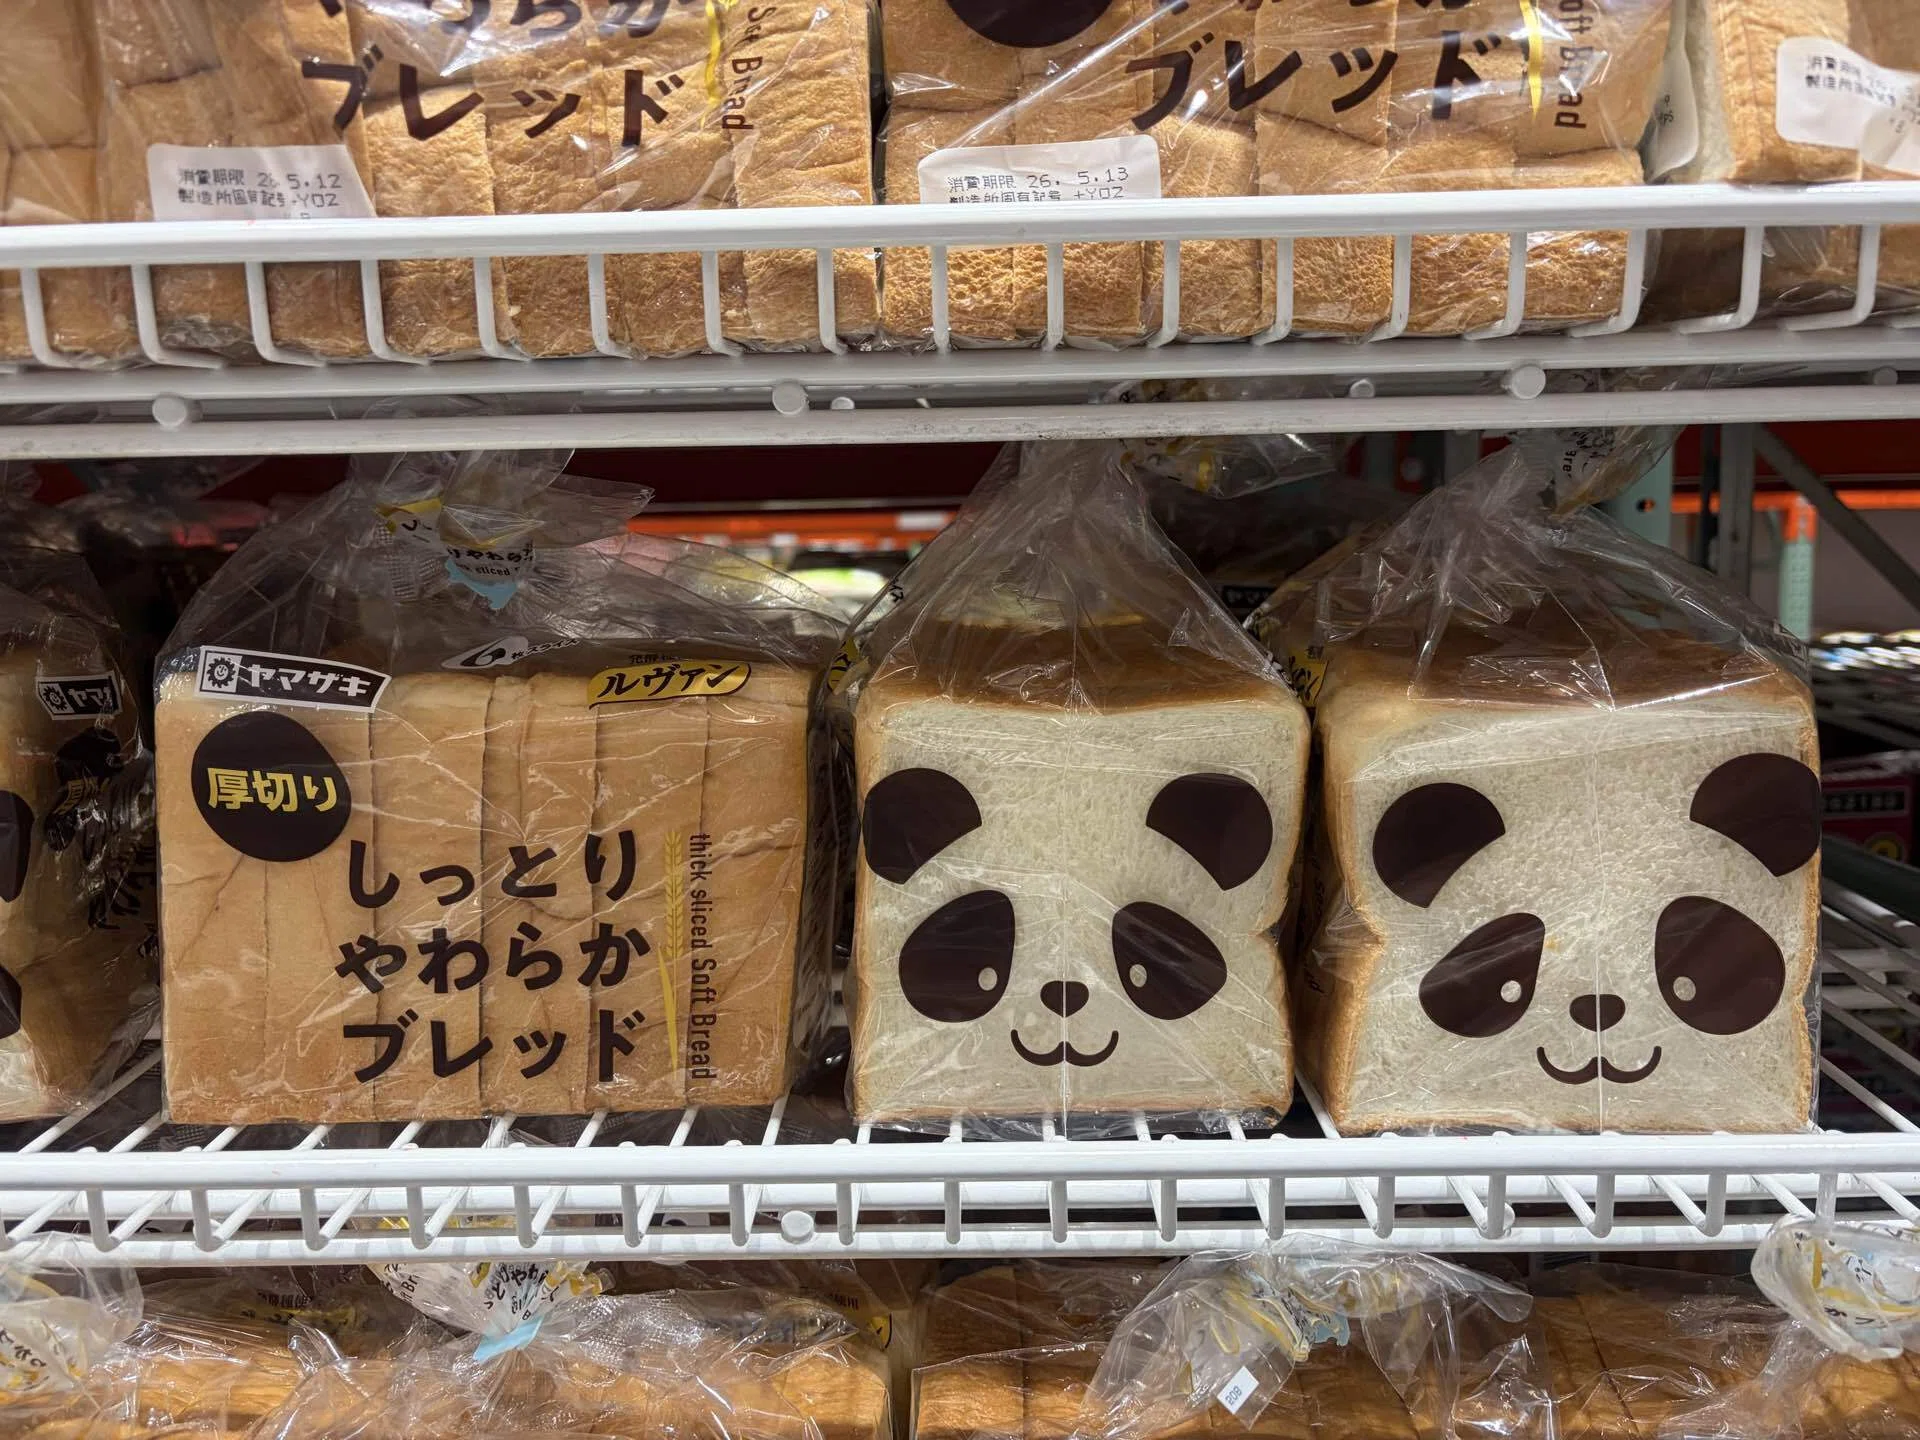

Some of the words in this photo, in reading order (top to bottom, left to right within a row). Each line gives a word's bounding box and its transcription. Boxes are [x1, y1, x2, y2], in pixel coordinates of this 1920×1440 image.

[302, 44, 686, 147] ブレッド
[1125, 32, 1502, 131] ブレッド
[948, 175, 1016, 192] 消費期限
[247, 664, 371, 697] ヤマザキ
[597, 664, 740, 698] ルヴァン
[207, 767, 337, 812] 厚切り
[349, 830, 637, 909] しっとり
[689, 833, 713, 881] thick
[690, 889, 713, 949] sliced
[335, 921, 651, 994] やわらか
[690, 958, 717, 1004] Soft
[343, 1008, 646, 1083] ブレッド
[690, 1013, 717, 1080] Bread
